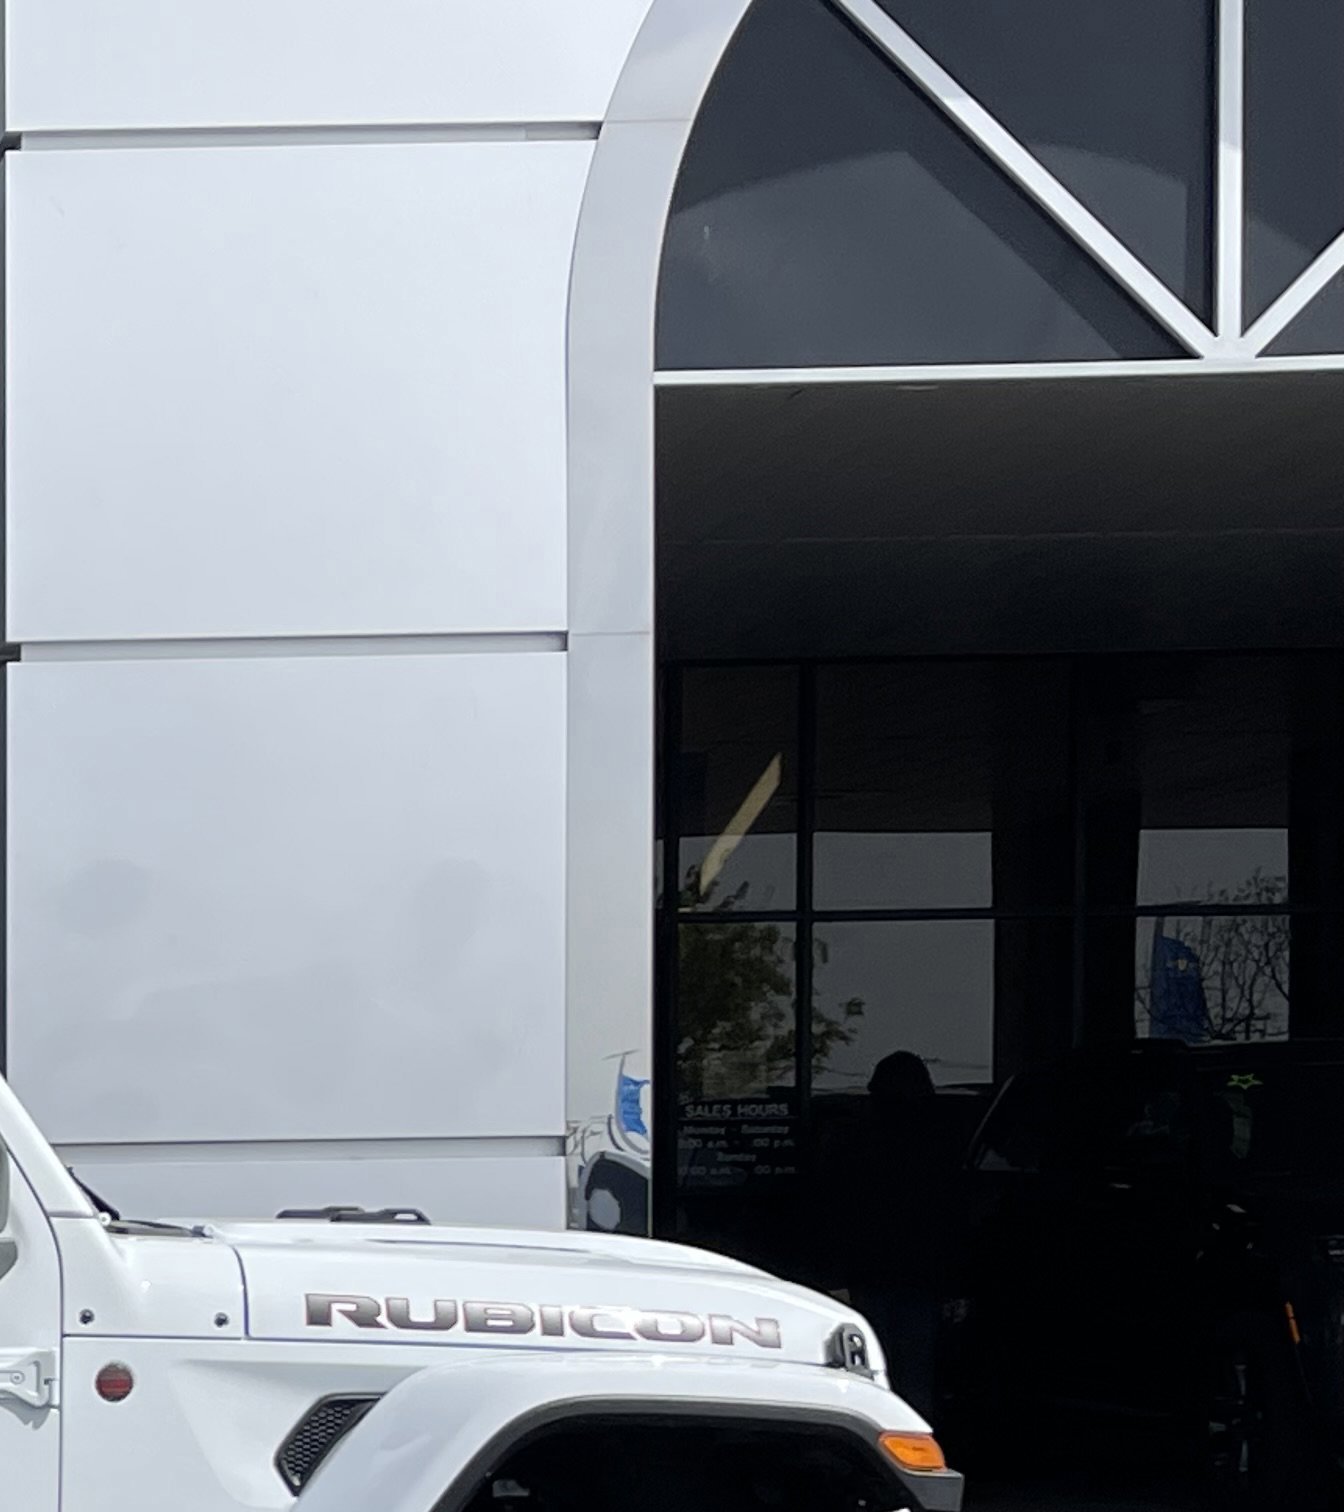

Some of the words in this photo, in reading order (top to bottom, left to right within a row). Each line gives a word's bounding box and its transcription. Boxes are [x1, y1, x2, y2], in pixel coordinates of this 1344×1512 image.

[685, 1104, 732, 1118] SALES
[736, 1103, 789, 1117] HOURS
[306, 1293, 783, 1349] RUBICON
